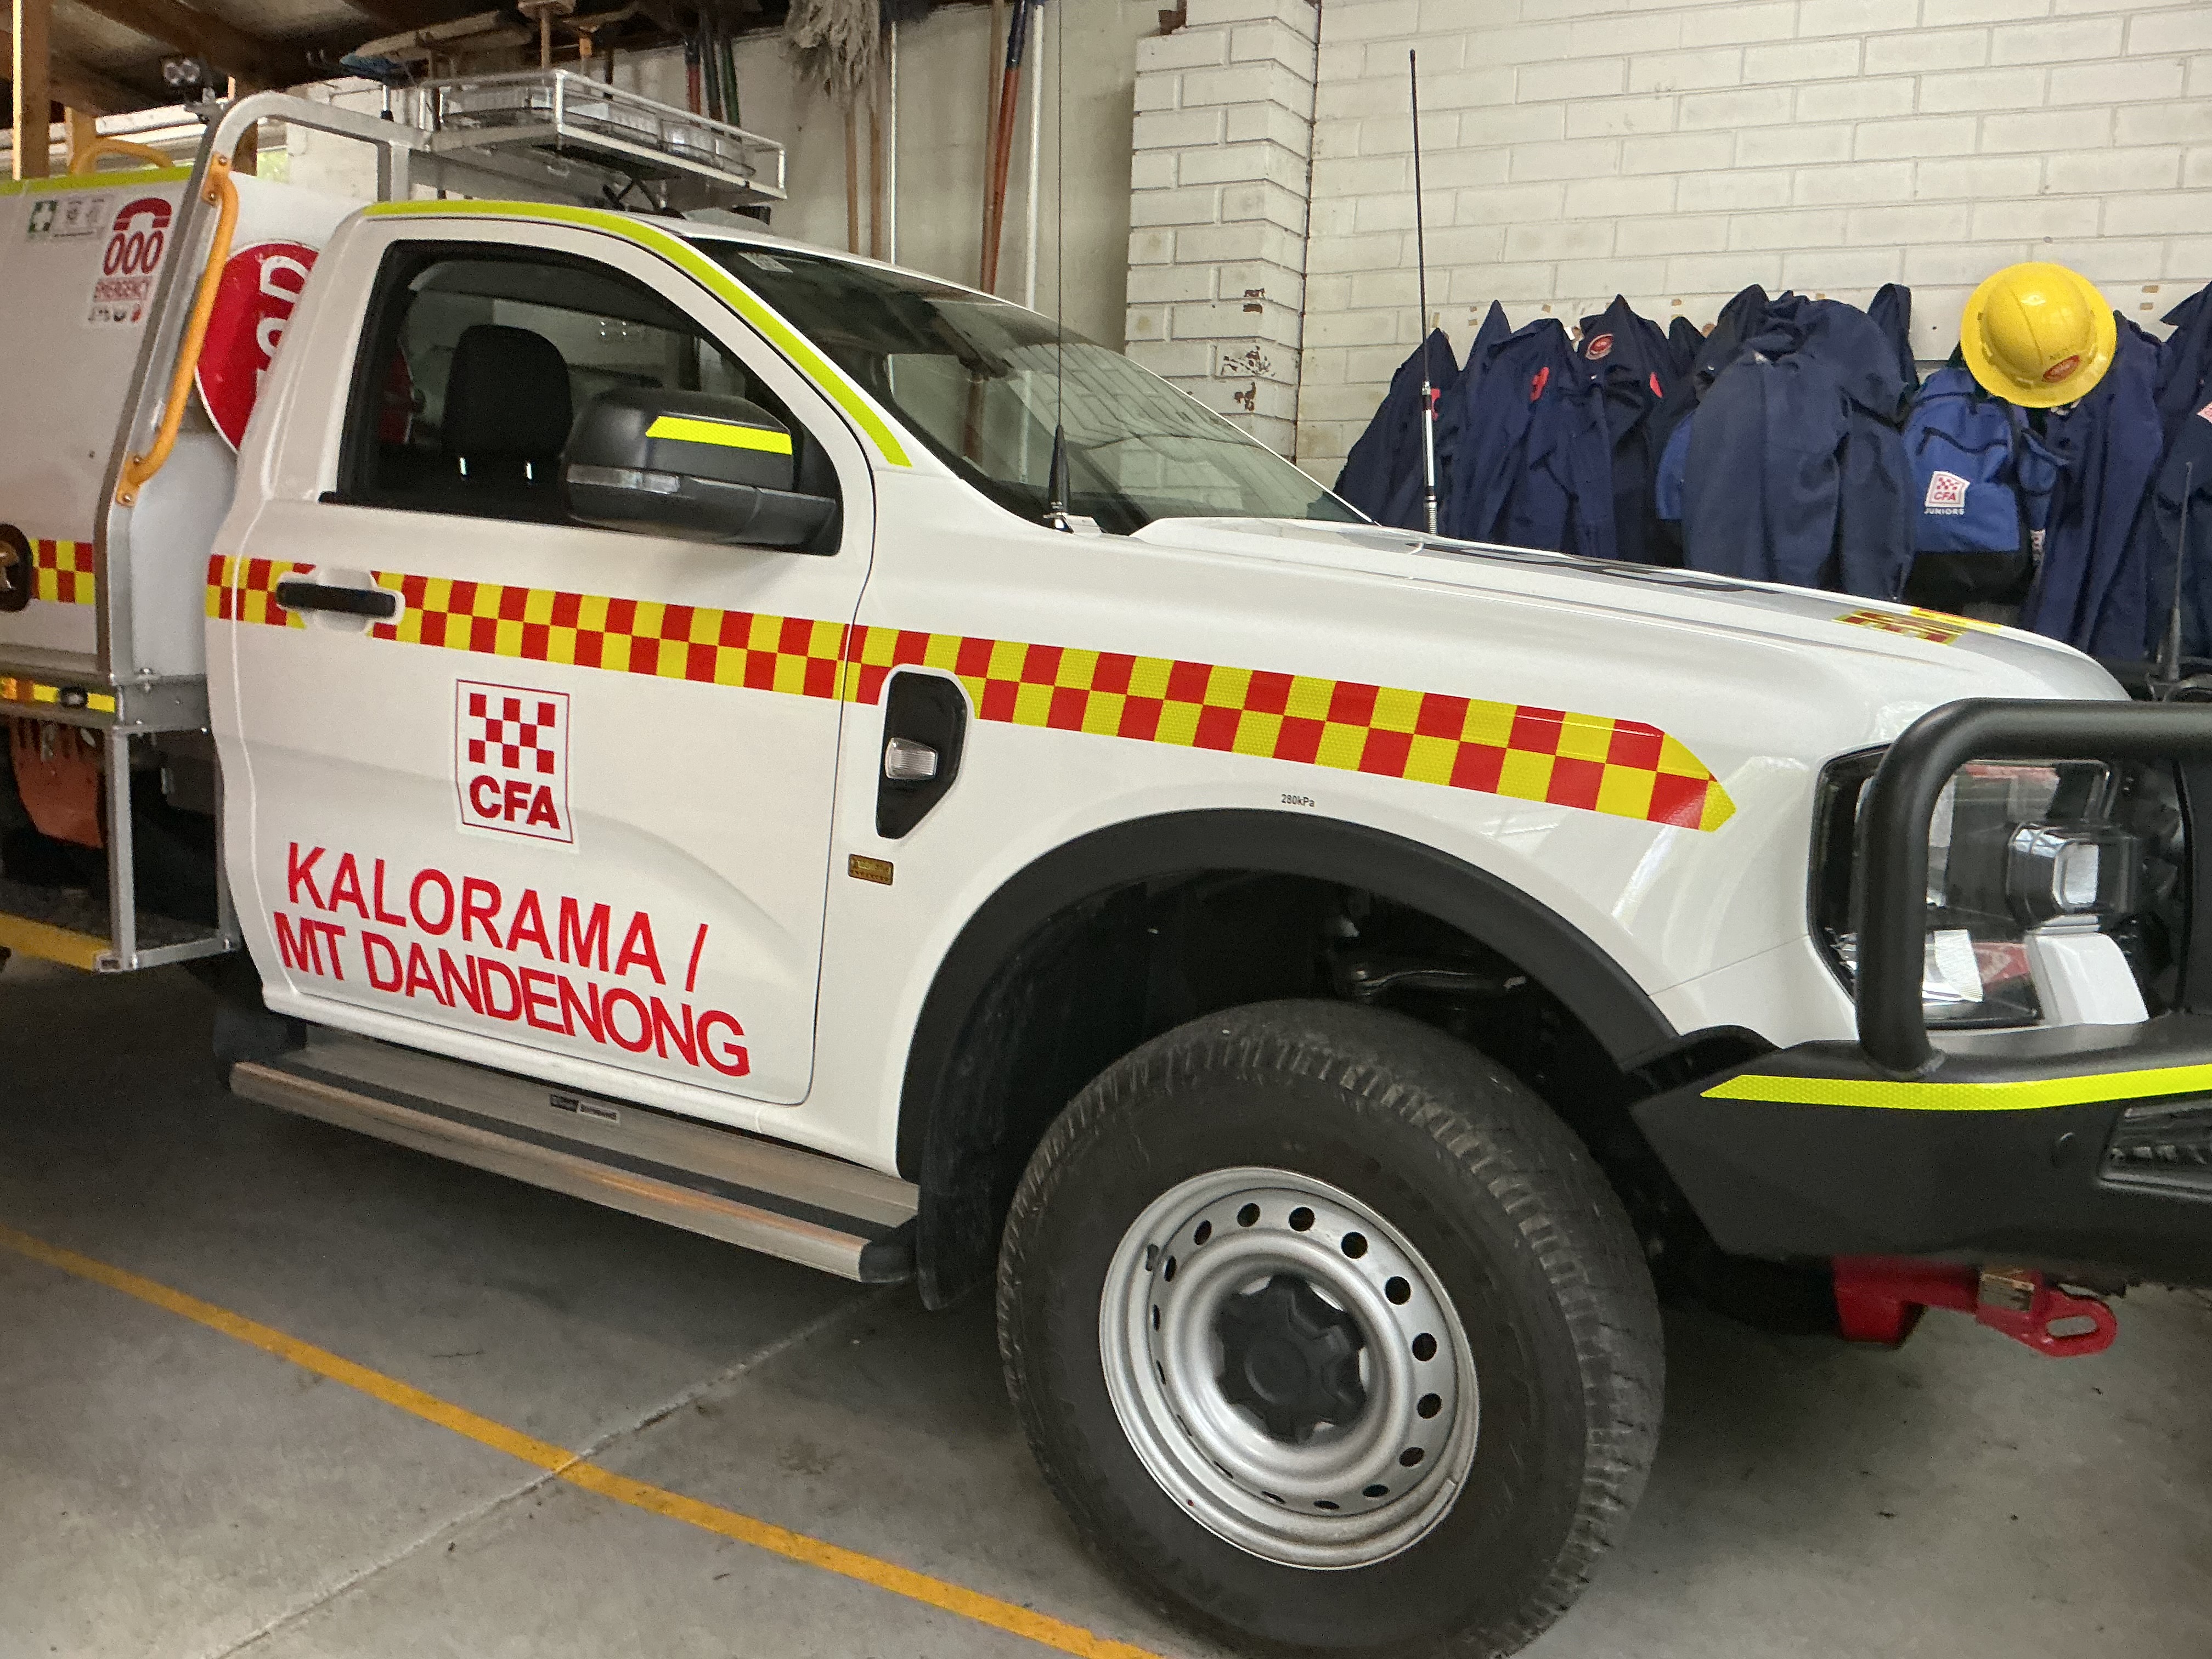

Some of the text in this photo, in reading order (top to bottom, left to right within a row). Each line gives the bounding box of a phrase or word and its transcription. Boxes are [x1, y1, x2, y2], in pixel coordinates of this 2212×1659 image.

[104, 230, 164, 276] 000
[1934, 492, 1956, 501] CFA
[469, 775, 561, 830] CFA
[1281, 793, 1315, 807] 280kPa
[287, 842, 709, 992] KALORAMA /
[274, 911, 751, 1077] MT DANDENONG
